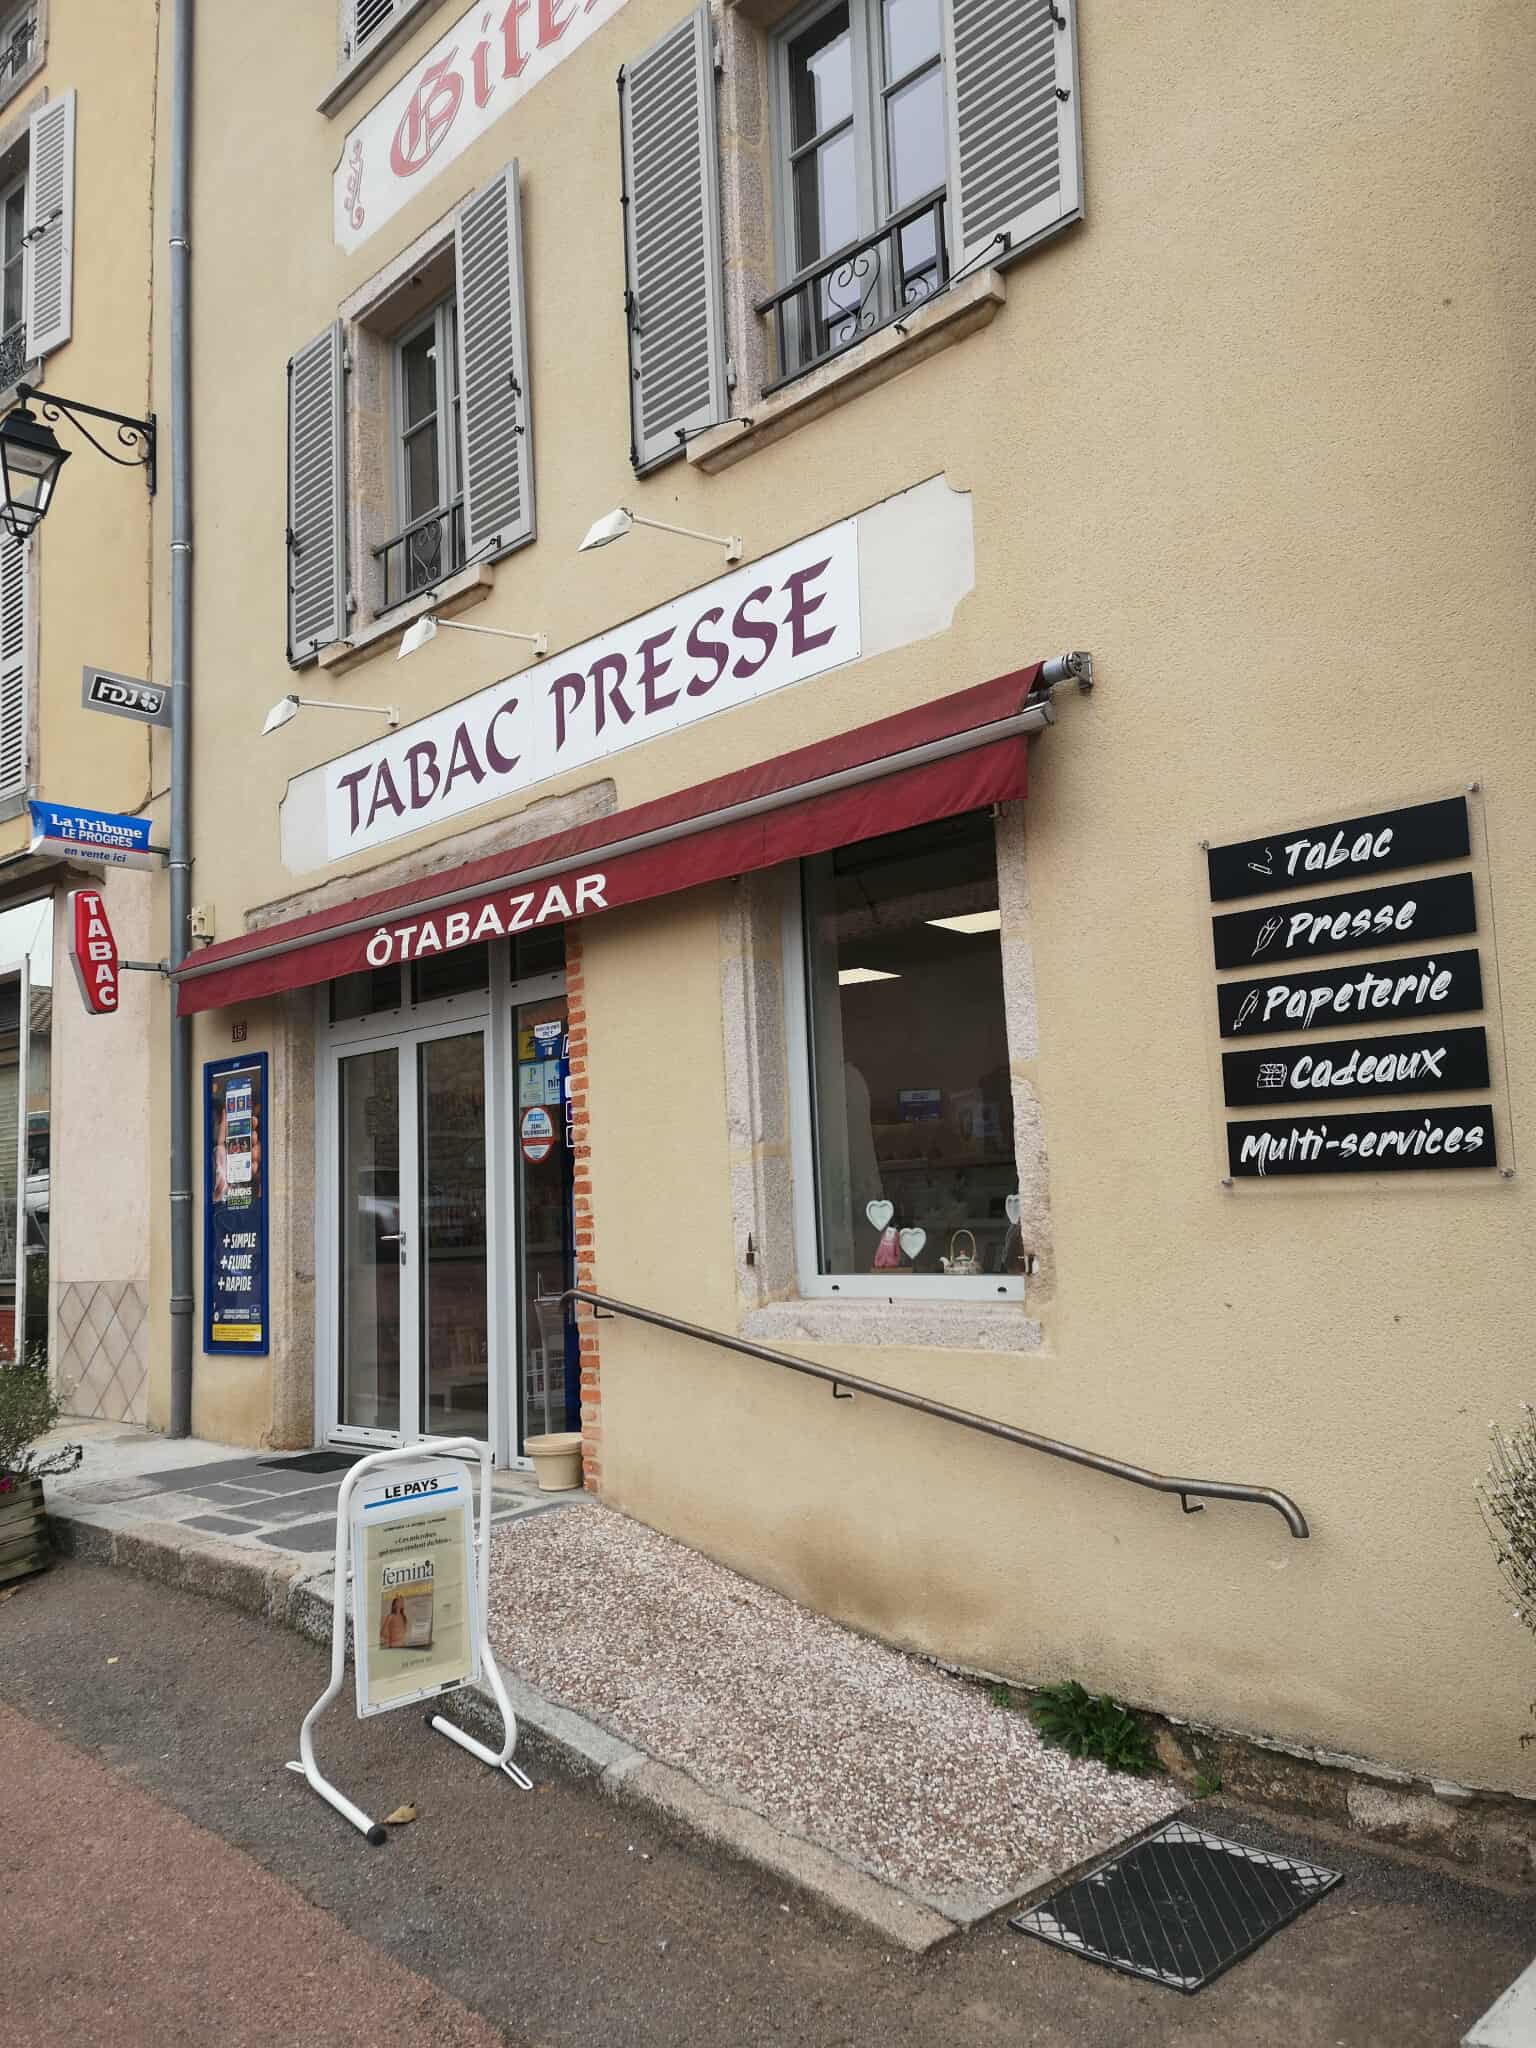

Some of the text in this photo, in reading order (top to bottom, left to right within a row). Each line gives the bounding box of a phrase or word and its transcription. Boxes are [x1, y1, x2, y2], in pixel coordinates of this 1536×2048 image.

[390, 0, 600, 178] Gite
[97, 682, 138, 706] FDJ
[336, 556, 838, 837] TABAC PRESSE
[50, 813, 144, 839] La Tribune
[62, 826, 76, 839] LE
[64, 846, 126, 863] en vente ici
[1284, 827, 1395, 877] Tabac
[365, 873, 609, 968] ÔTABAZAR
[1285, 899, 1418, 948] Presse
[83, 895, 117, 1007] TABAC
[1262, 960, 1453, 1030] Papeterie
[1289, 1046, 1447, 1089] Cadeaux
[1239, 1119, 1484, 1177] Multi-services
[384, 1478, 439, 1500] LE PAYS
[382, 1560, 434, 1586] femina
